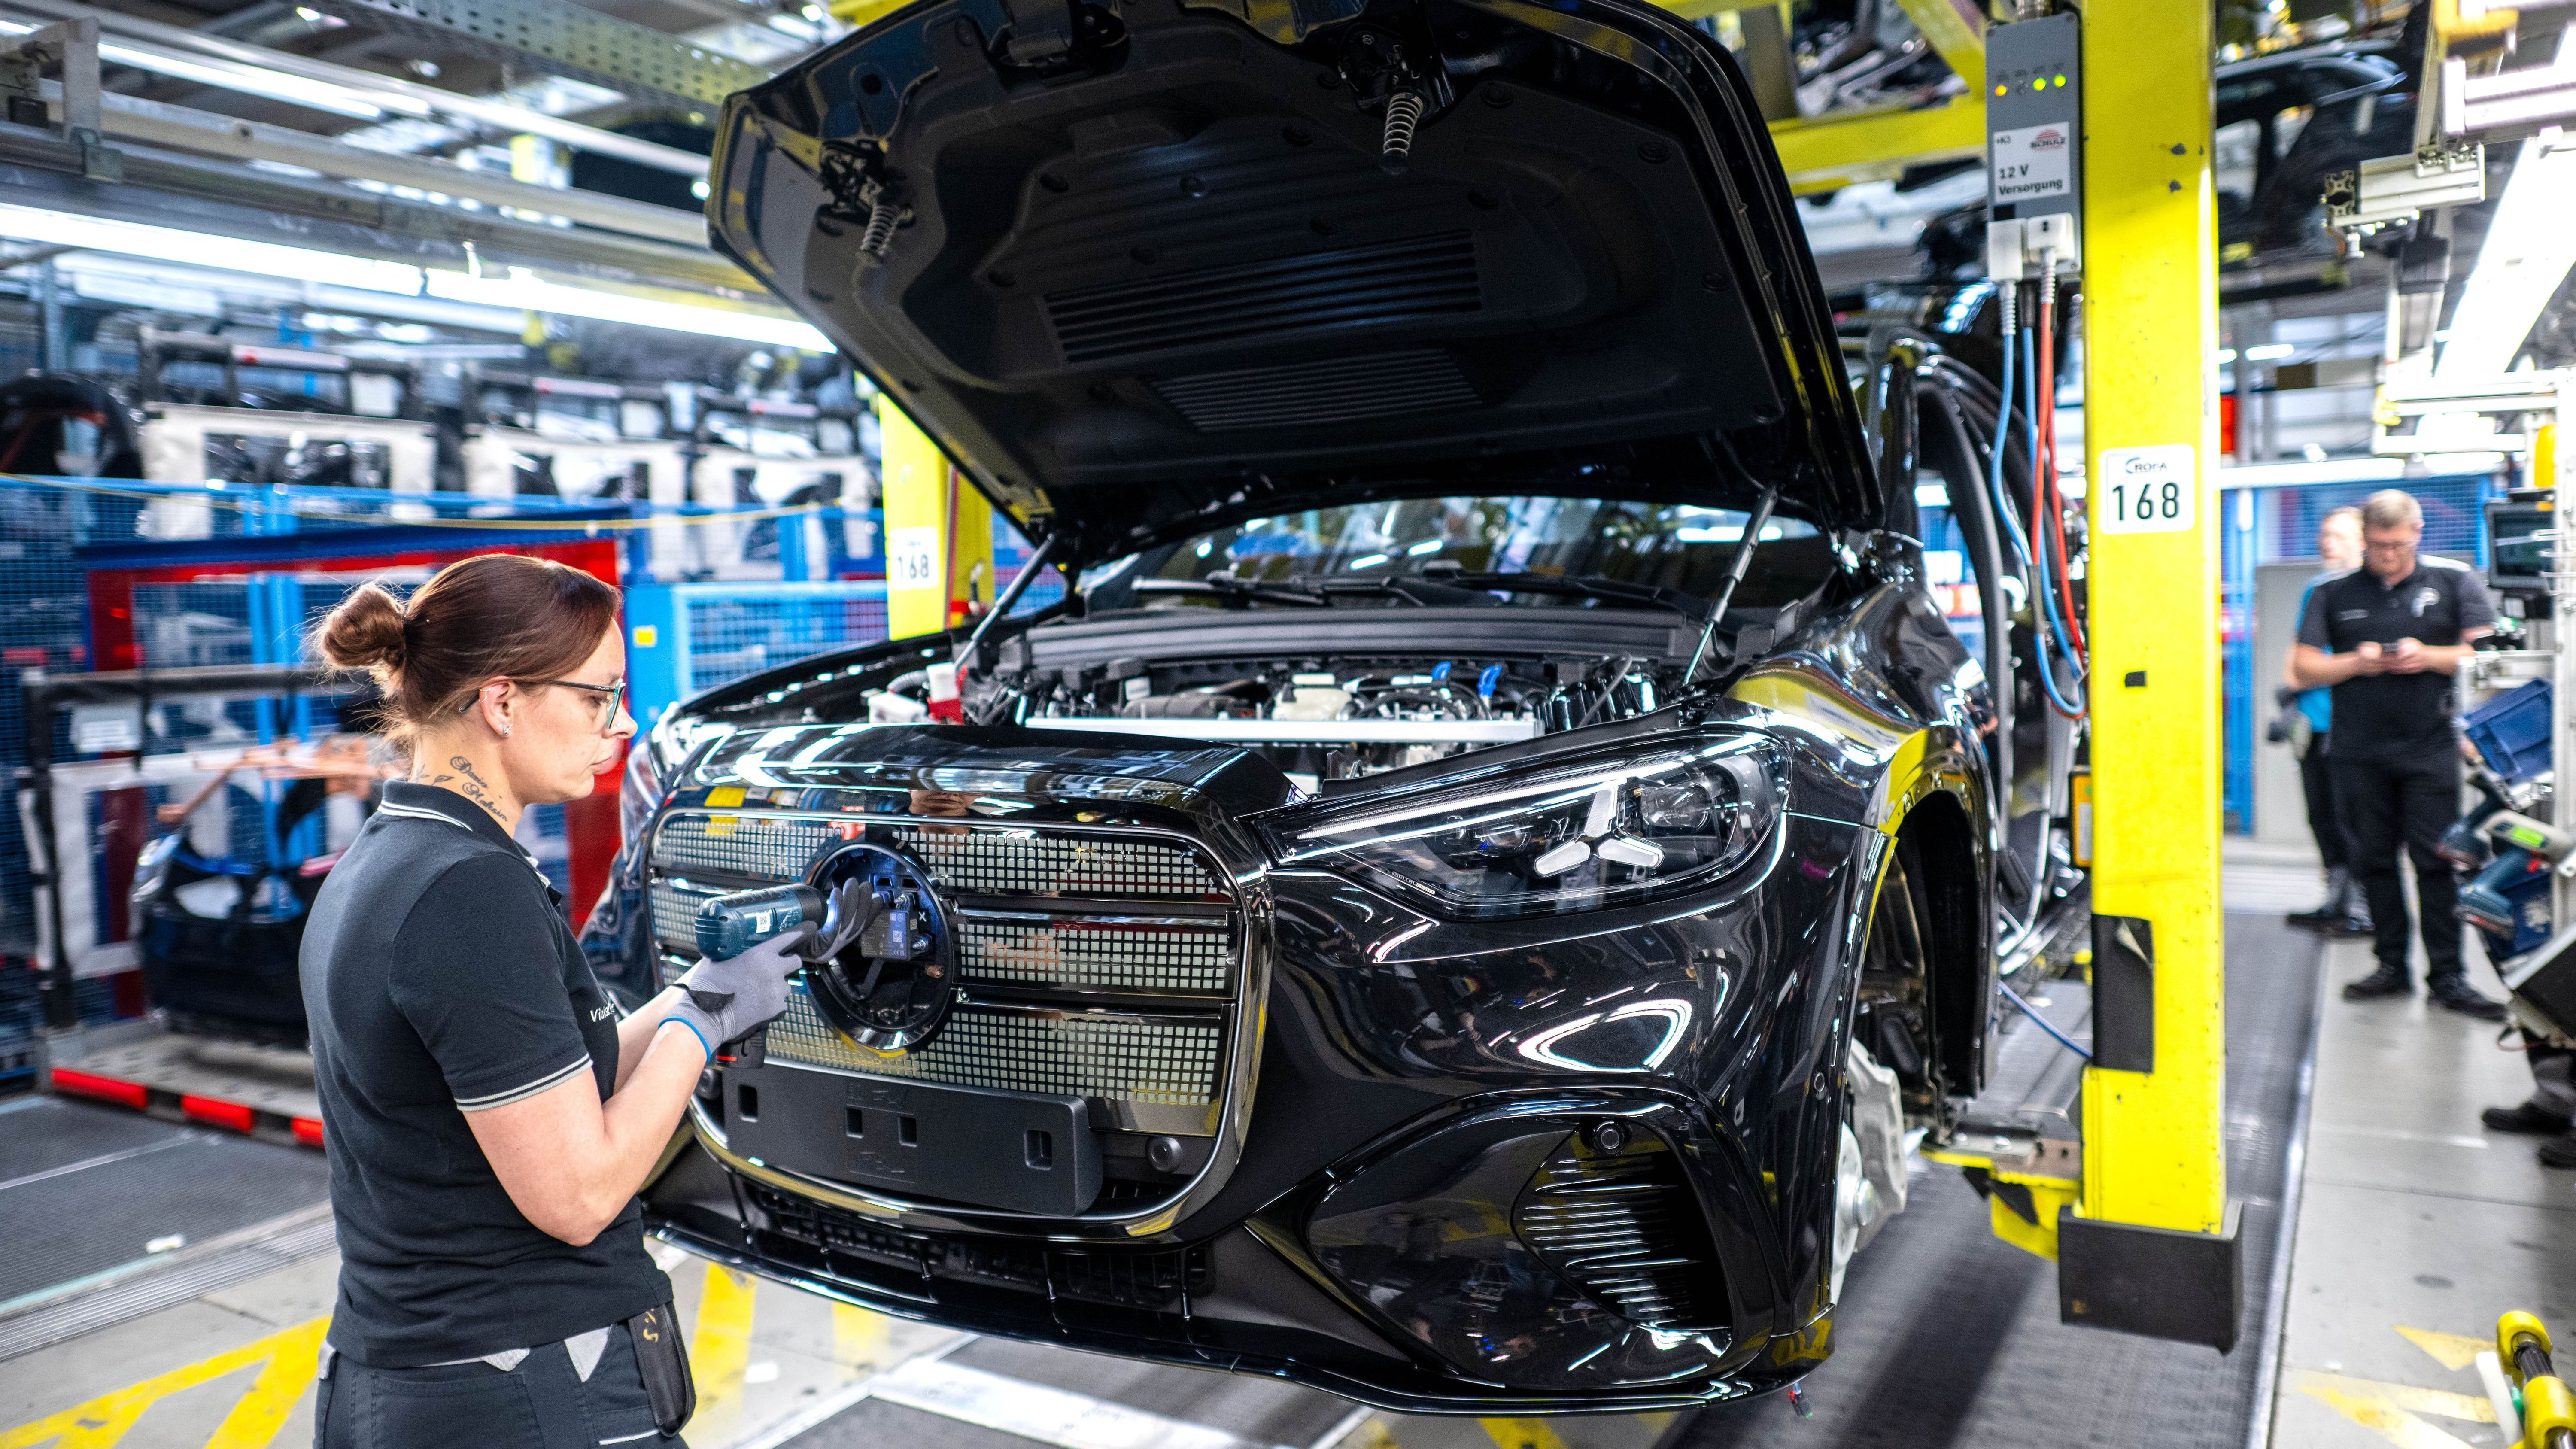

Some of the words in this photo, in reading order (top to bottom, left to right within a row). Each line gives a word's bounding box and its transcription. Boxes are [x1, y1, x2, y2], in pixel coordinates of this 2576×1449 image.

[2030, 137, 2066, 148] SCHULZ
[1999, 166, 2015, 179] 12
[2020, 163, 2029, 176] V
[1999, 179, 2063, 195] Versorgung
[2112, 482, 2180, 521] 168
[897, 553, 929, 580] 168
